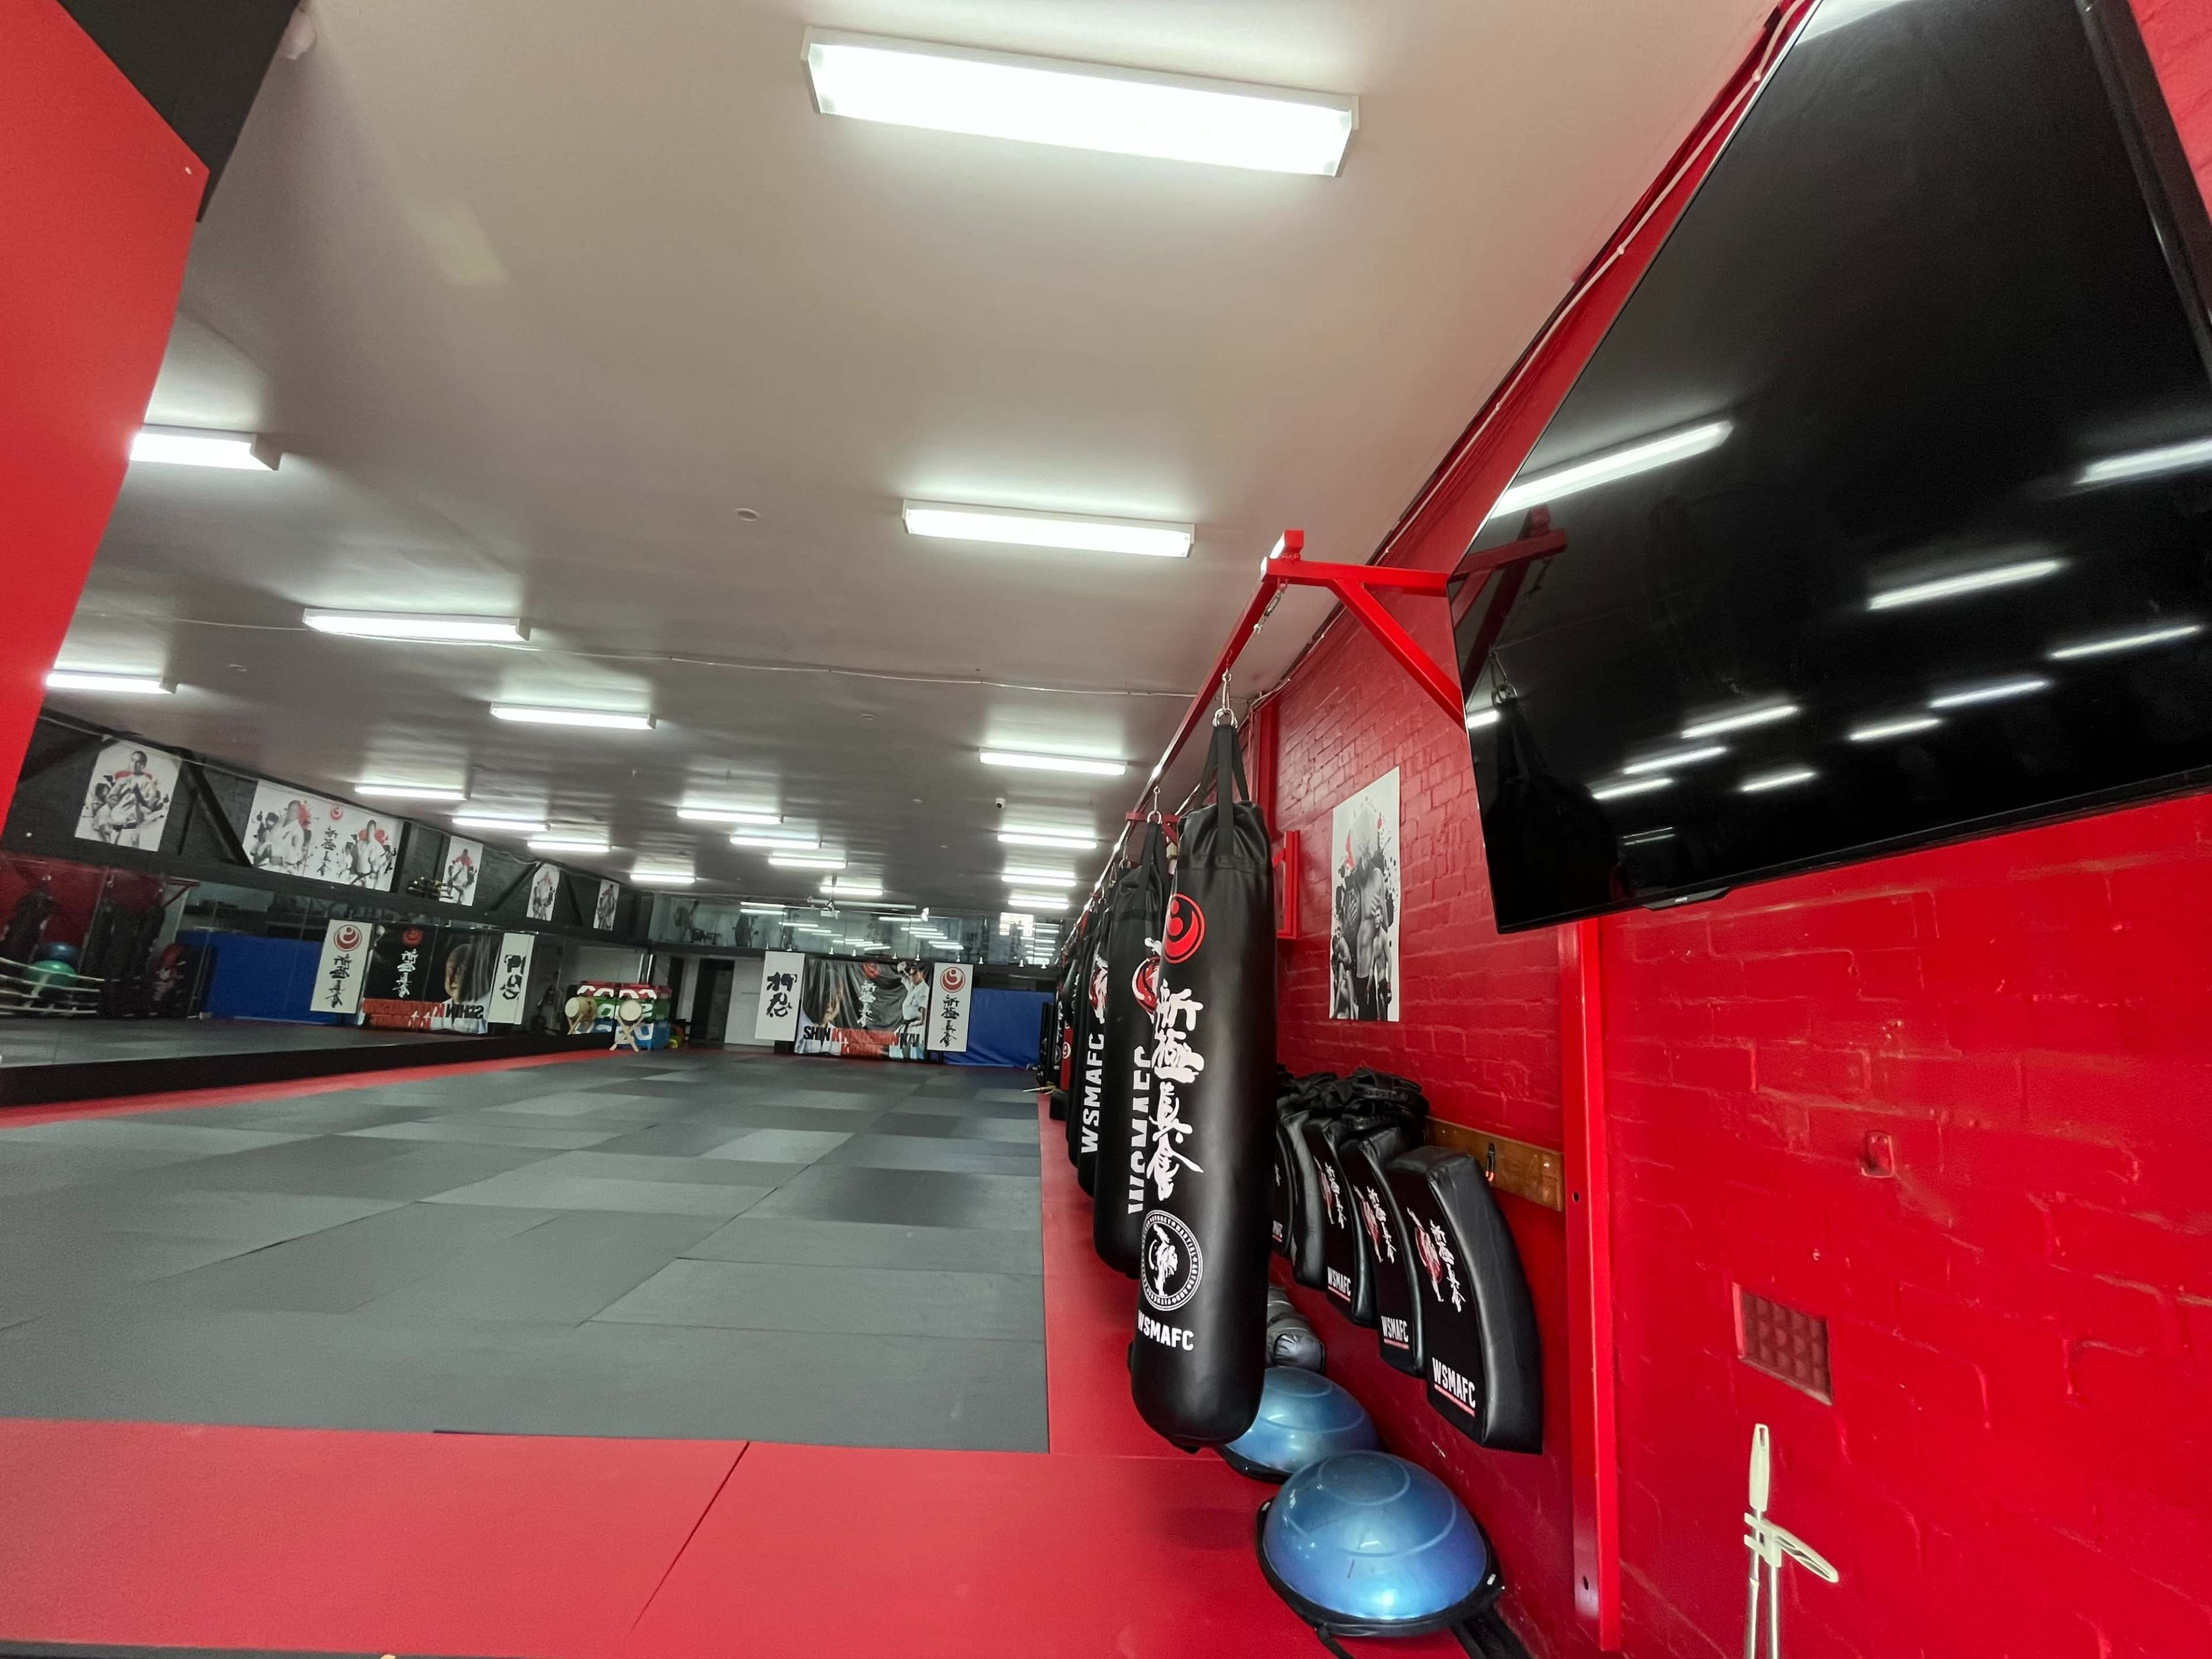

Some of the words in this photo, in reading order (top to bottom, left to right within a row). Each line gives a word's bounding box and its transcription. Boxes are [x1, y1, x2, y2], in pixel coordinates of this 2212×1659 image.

[1081, 1033, 1104, 1153] WSMAFC
[1327, 1266, 1351, 1296] WSMAFC
[1138, 1309, 1194, 1351] WSMAFC
[1381, 1316, 1408, 1343] WSMAFC
[1432, 1357, 1476, 1408] WSMAFC
